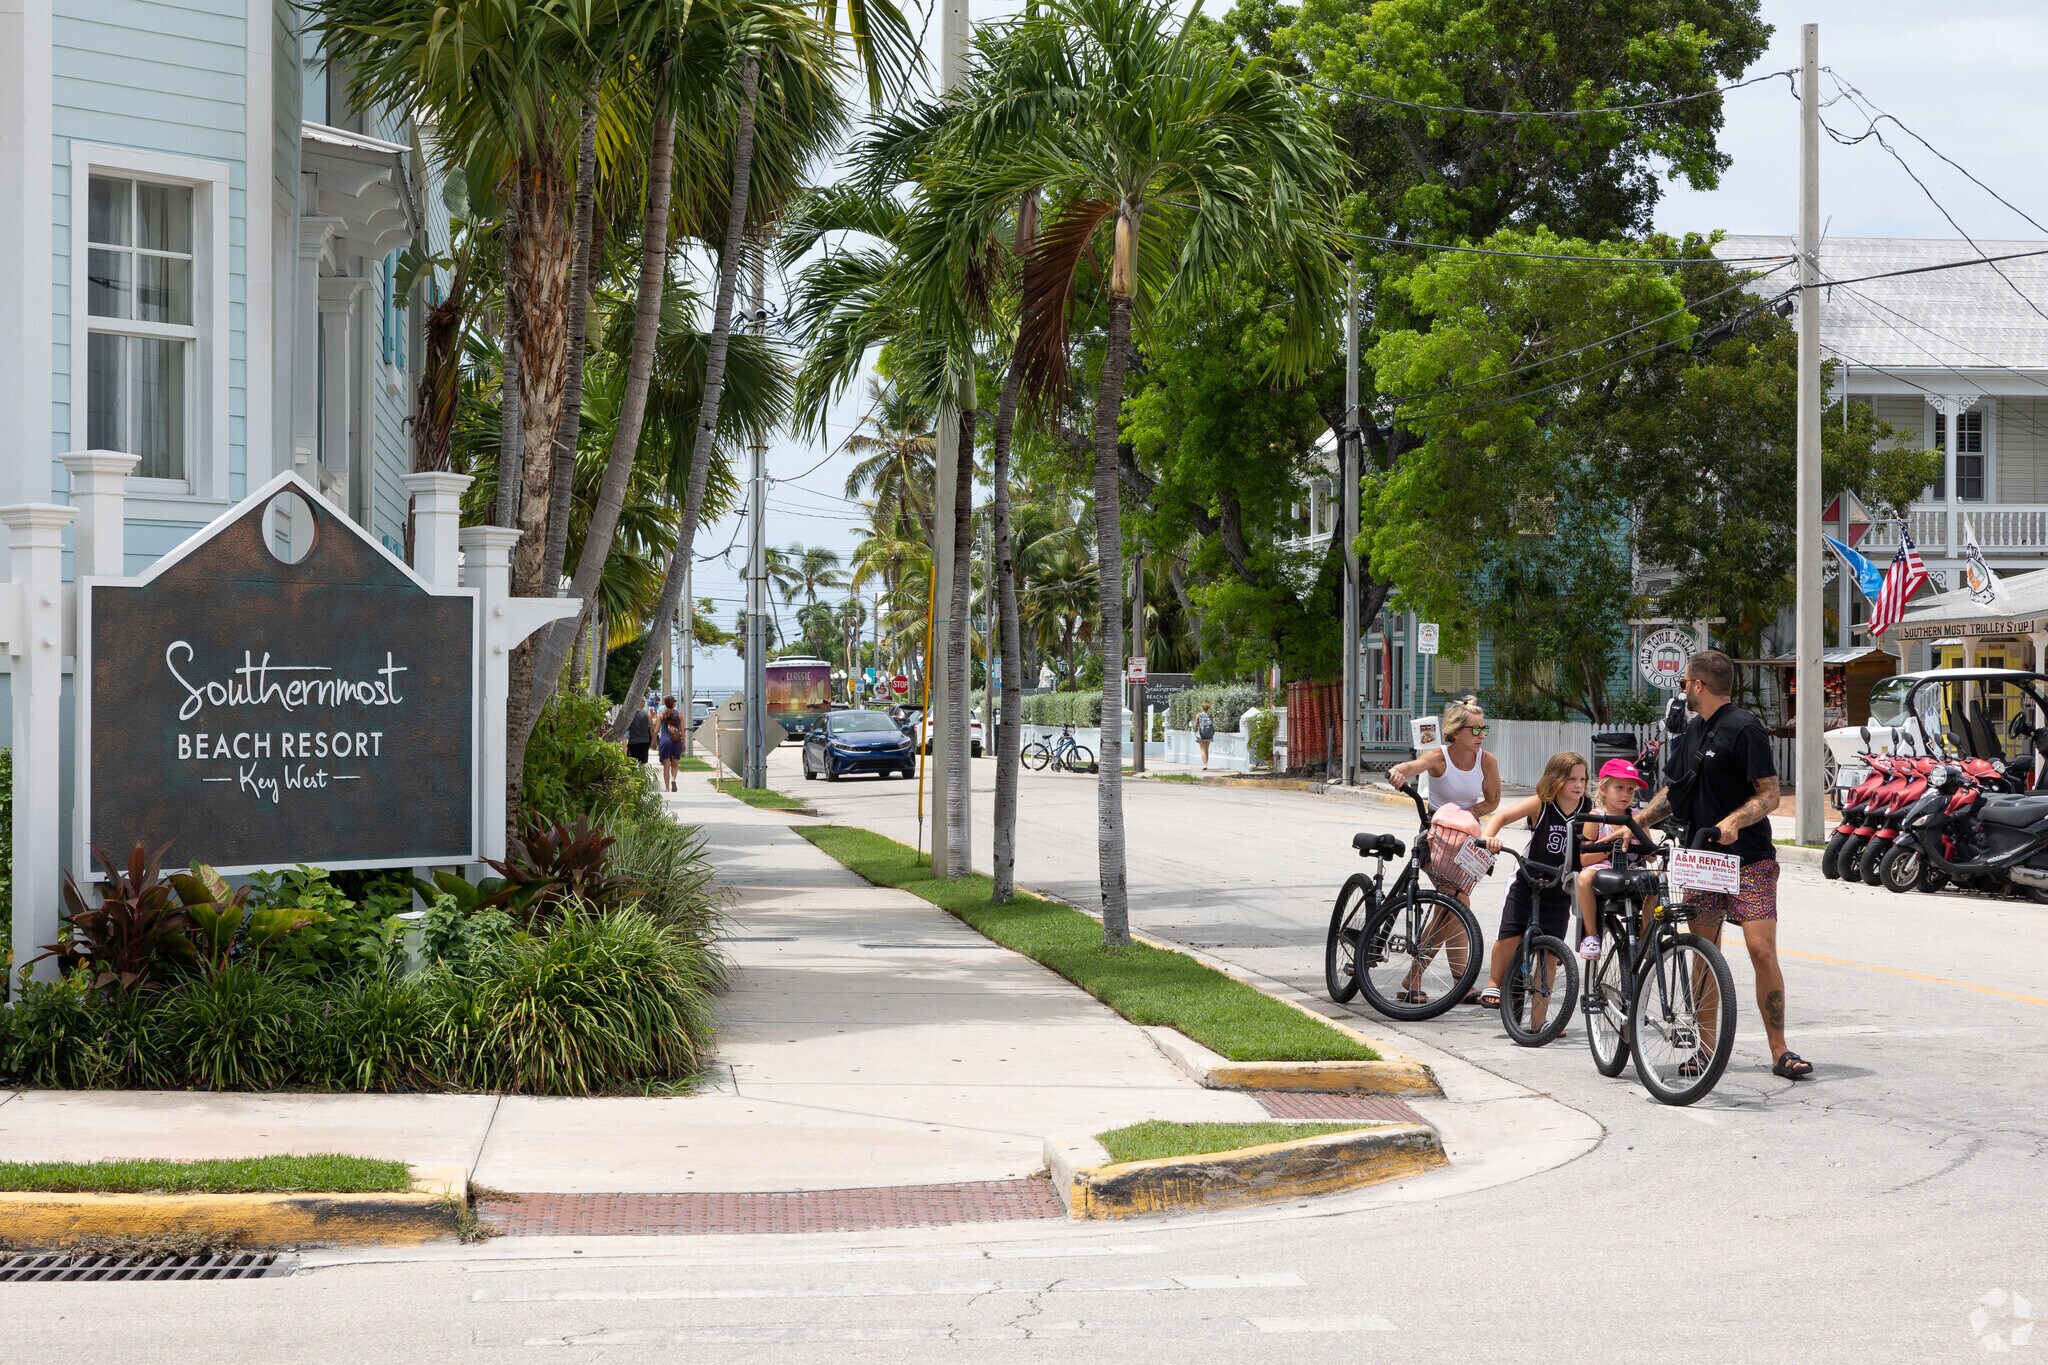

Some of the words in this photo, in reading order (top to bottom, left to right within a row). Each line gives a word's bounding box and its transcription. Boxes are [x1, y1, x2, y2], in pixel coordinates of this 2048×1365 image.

[1904, 625, 1942, 638] SOUTHERN
[1944, 624, 1966, 636] MOST
[1969, 622, 2005, 634] TROLLEY
[2007, 620, 2029, 633] STOP
[1641, 648, 1652, 665] OLD
[1647, 631, 1671, 648] TOWN
[1673, 632, 1697, 657] TROLL
[166, 640, 408, 721] Southernmost
[786, 672, 811, 681] CLASSIC
[892, 680, 908, 688] STOP
[178, 732, 271, 760] BEACH
[282, 732, 383, 758] RESORT
[239, 762, 279, 804] Key
[284, 763, 328, 789] West
[1674, 861, 1694, 869] Scooters,
[1675, 854, 1696, 863] A&M
[1699, 857, 1736, 869] RENTALS
